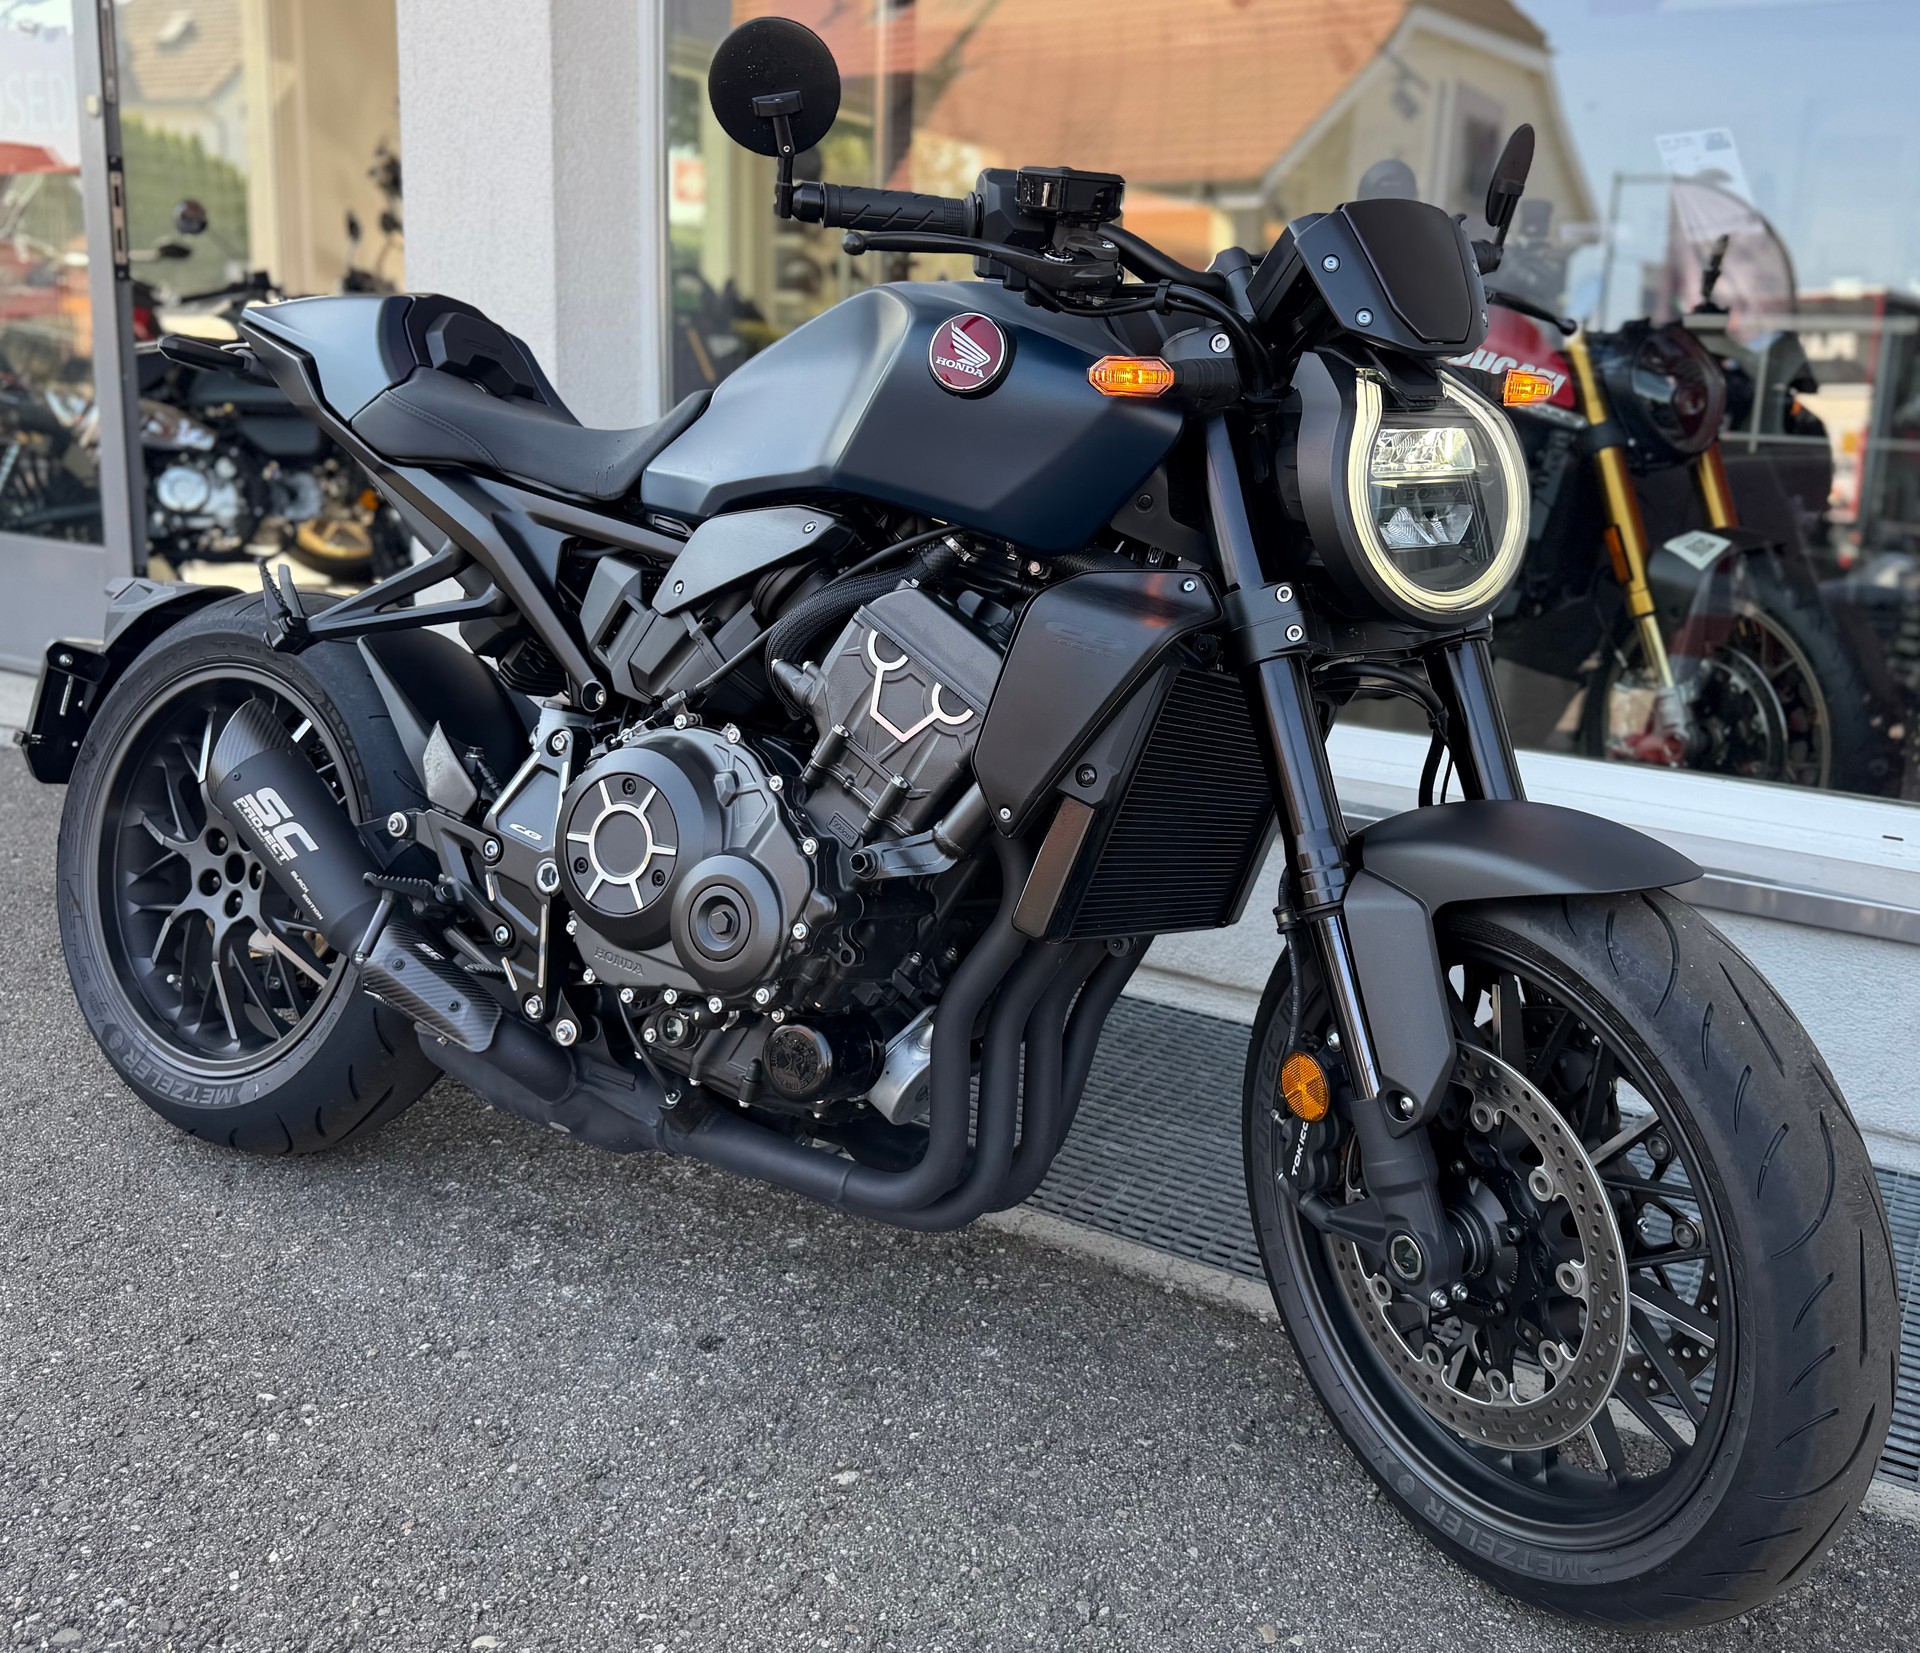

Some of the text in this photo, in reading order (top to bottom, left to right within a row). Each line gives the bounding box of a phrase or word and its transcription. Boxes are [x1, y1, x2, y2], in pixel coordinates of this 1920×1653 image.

[935, 356, 985, 379] HONDA
[1446, 348, 1567, 396] UCI
[236, 796, 291, 862] PROJECT
[243, 786, 320, 860] SC
[290, 870, 310, 893] BLACK
[302, 893, 324, 921] EDITION
[594, 946, 644, 977] HONDA
[122, 1048, 235, 1105] METZELER
[1423, 1495, 1580, 1581] METZELER
